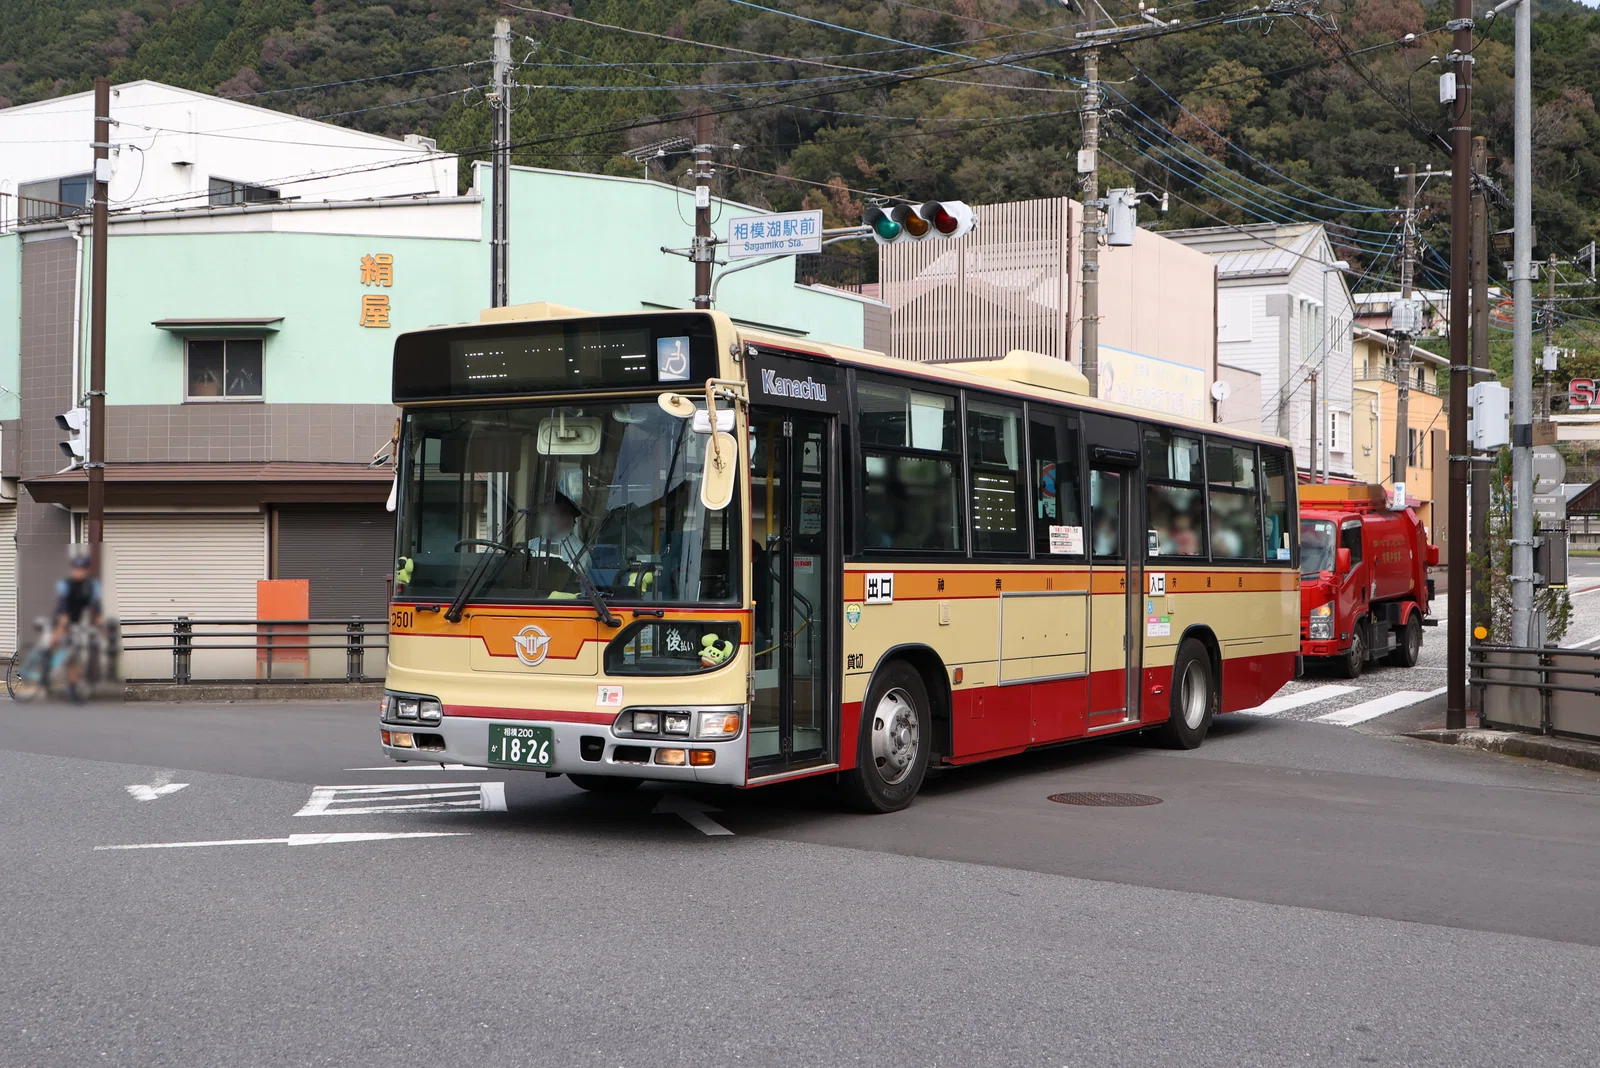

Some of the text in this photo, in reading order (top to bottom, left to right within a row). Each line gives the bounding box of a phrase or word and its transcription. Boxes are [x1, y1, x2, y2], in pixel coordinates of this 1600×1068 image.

[734, 217, 815, 240] 相模湖駅前
[744, 238, 804, 252] Sagamiko Sta.
[359, 253, 393, 328] 絹屋
[761, 368, 827, 401] Kanachu
[1569, 378, 1600, 406] S
[867, 578, 892, 599] 出口
[1150, 577, 1164, 592] 入口
[666, 628, 694, 651] 後払い
[502, 737, 549, 764] 18-26
